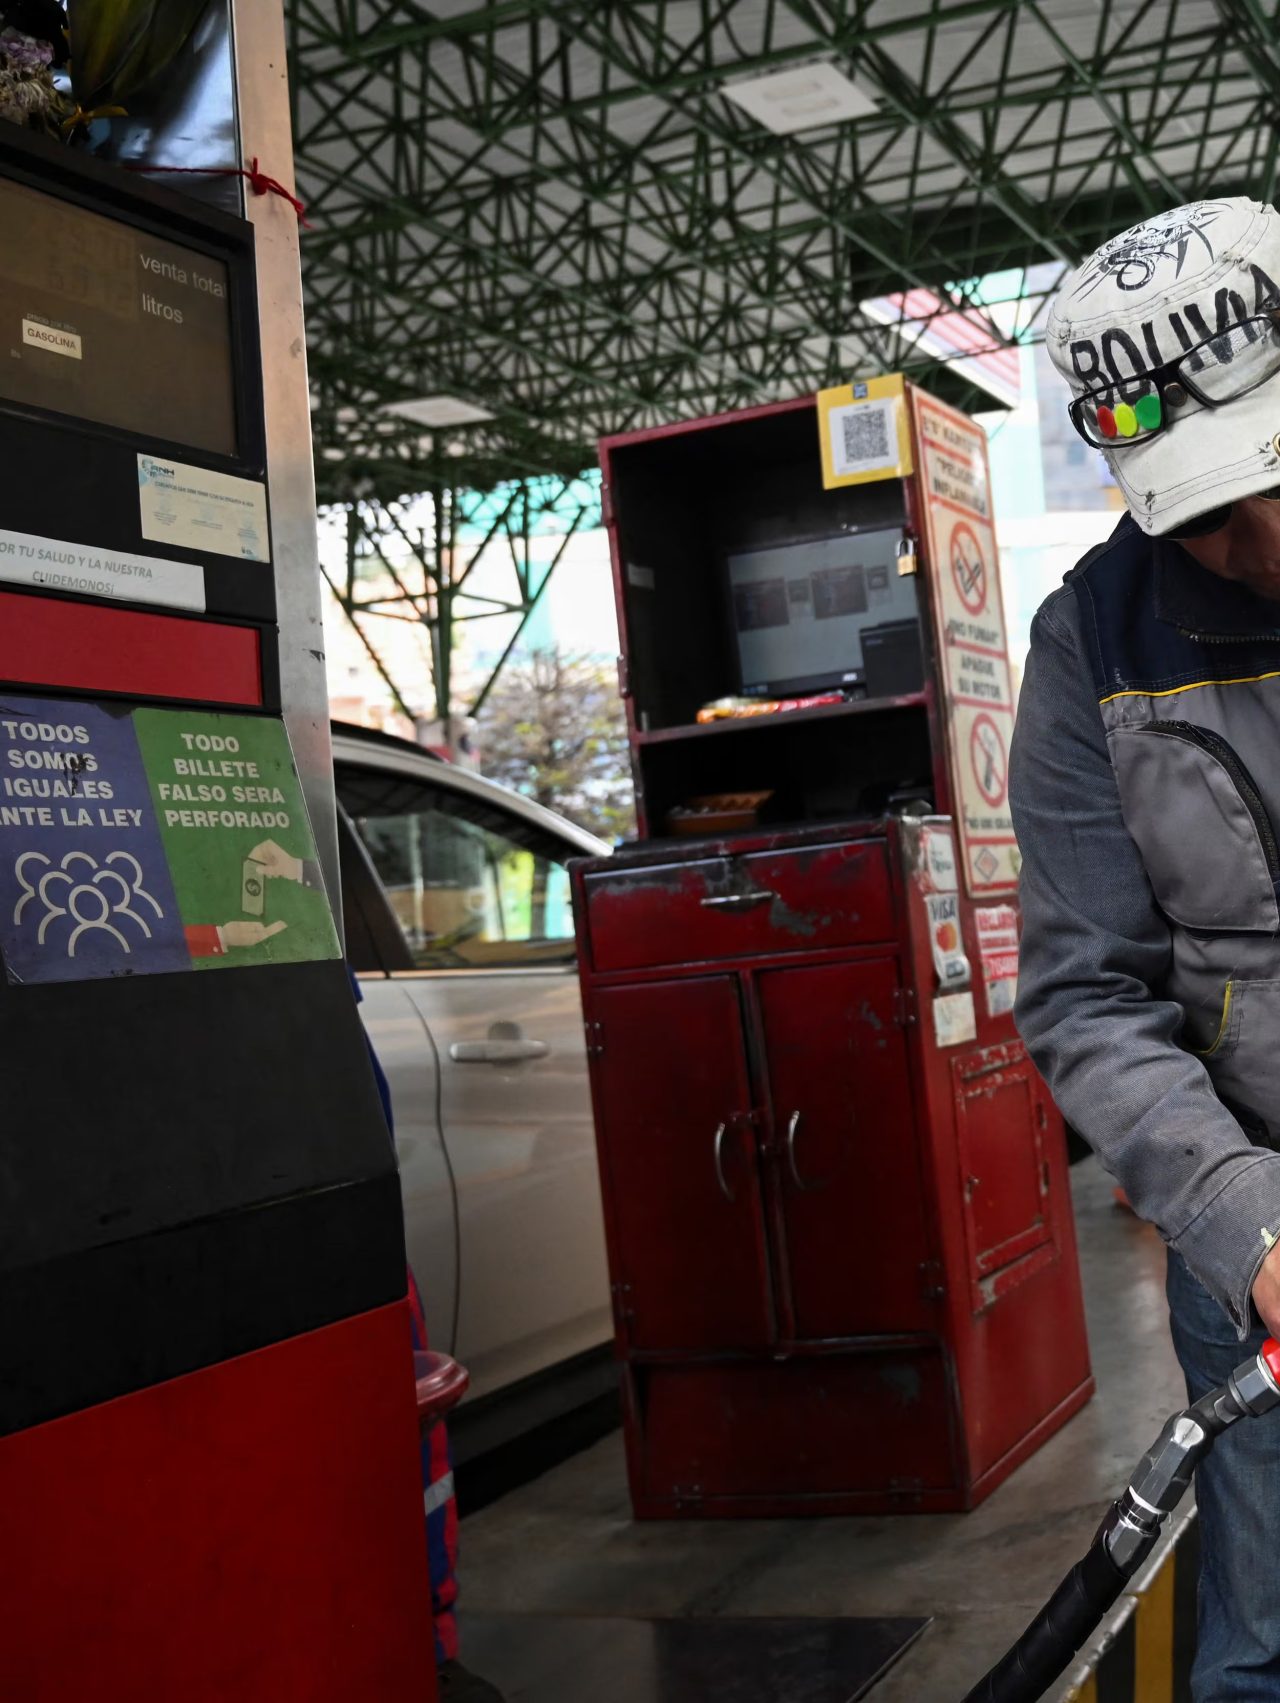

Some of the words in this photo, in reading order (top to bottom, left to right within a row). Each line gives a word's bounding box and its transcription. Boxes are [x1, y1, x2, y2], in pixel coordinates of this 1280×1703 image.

[140, 254, 188, 285] venta
[142, 293, 183, 324] litros
[27, 328, 77, 350] GASOLINA
[19, 545, 35, 558] TU
[37, 549, 75, 566] SALUD
[79, 557, 86, 567] Y
[88, 560, 101, 571] LA
[104, 561, 153, 579] NUESTRA
[2, 720, 90, 744] TODOS
[180, 733, 240, 753] TODO
[7, 749, 98, 772] SOMOS
[173, 758, 260, 778] BILLETE
[3, 777, 114, 799] IGUALES
[158, 783, 227, 802] FALSO
[231, 786, 285, 804] SERA
[0, 806, 55, 826] NTE
[60, 808, 94, 826] LA
[99, 808, 142, 827] LEY
[164, 809, 290, 828] PERFORADO
[931, 899, 956, 921] VISA
